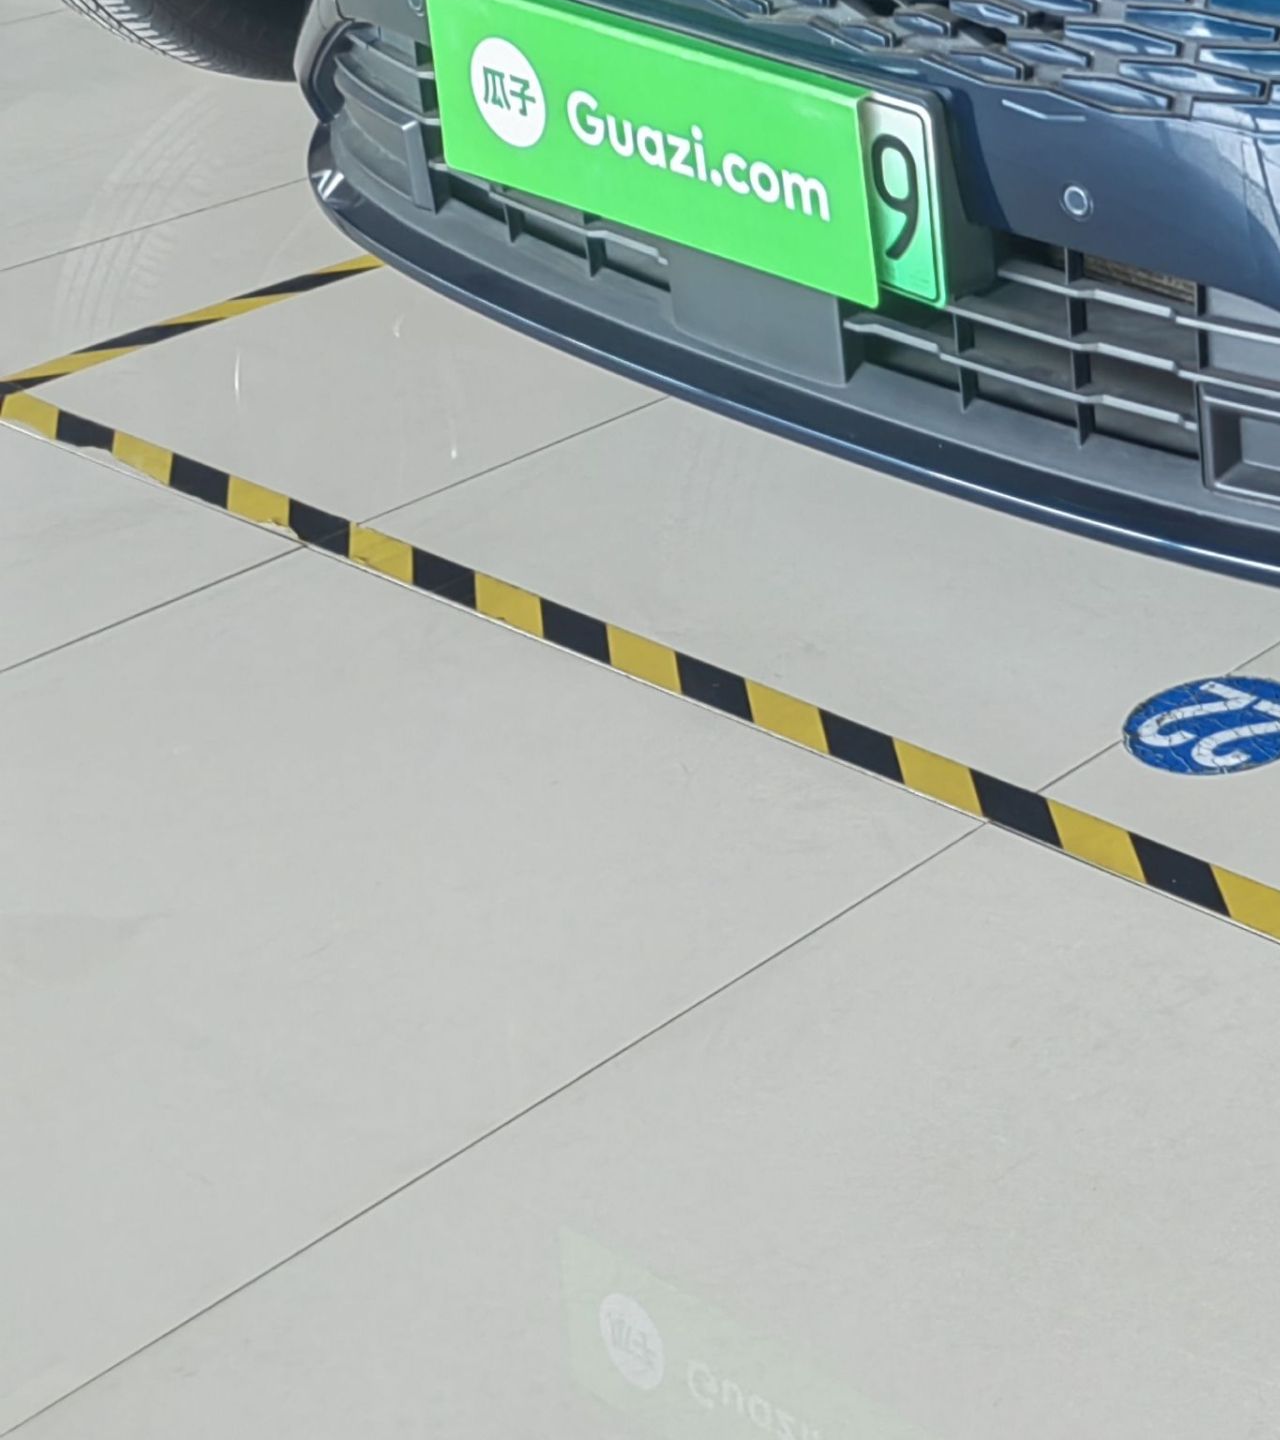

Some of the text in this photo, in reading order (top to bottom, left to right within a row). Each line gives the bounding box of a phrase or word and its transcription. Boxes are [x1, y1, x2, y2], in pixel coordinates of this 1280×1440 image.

[482, 65, 536, 117] 瓜子
[566, 89, 831, 222] Guazi.com
[870, 133, 919, 260] 9
